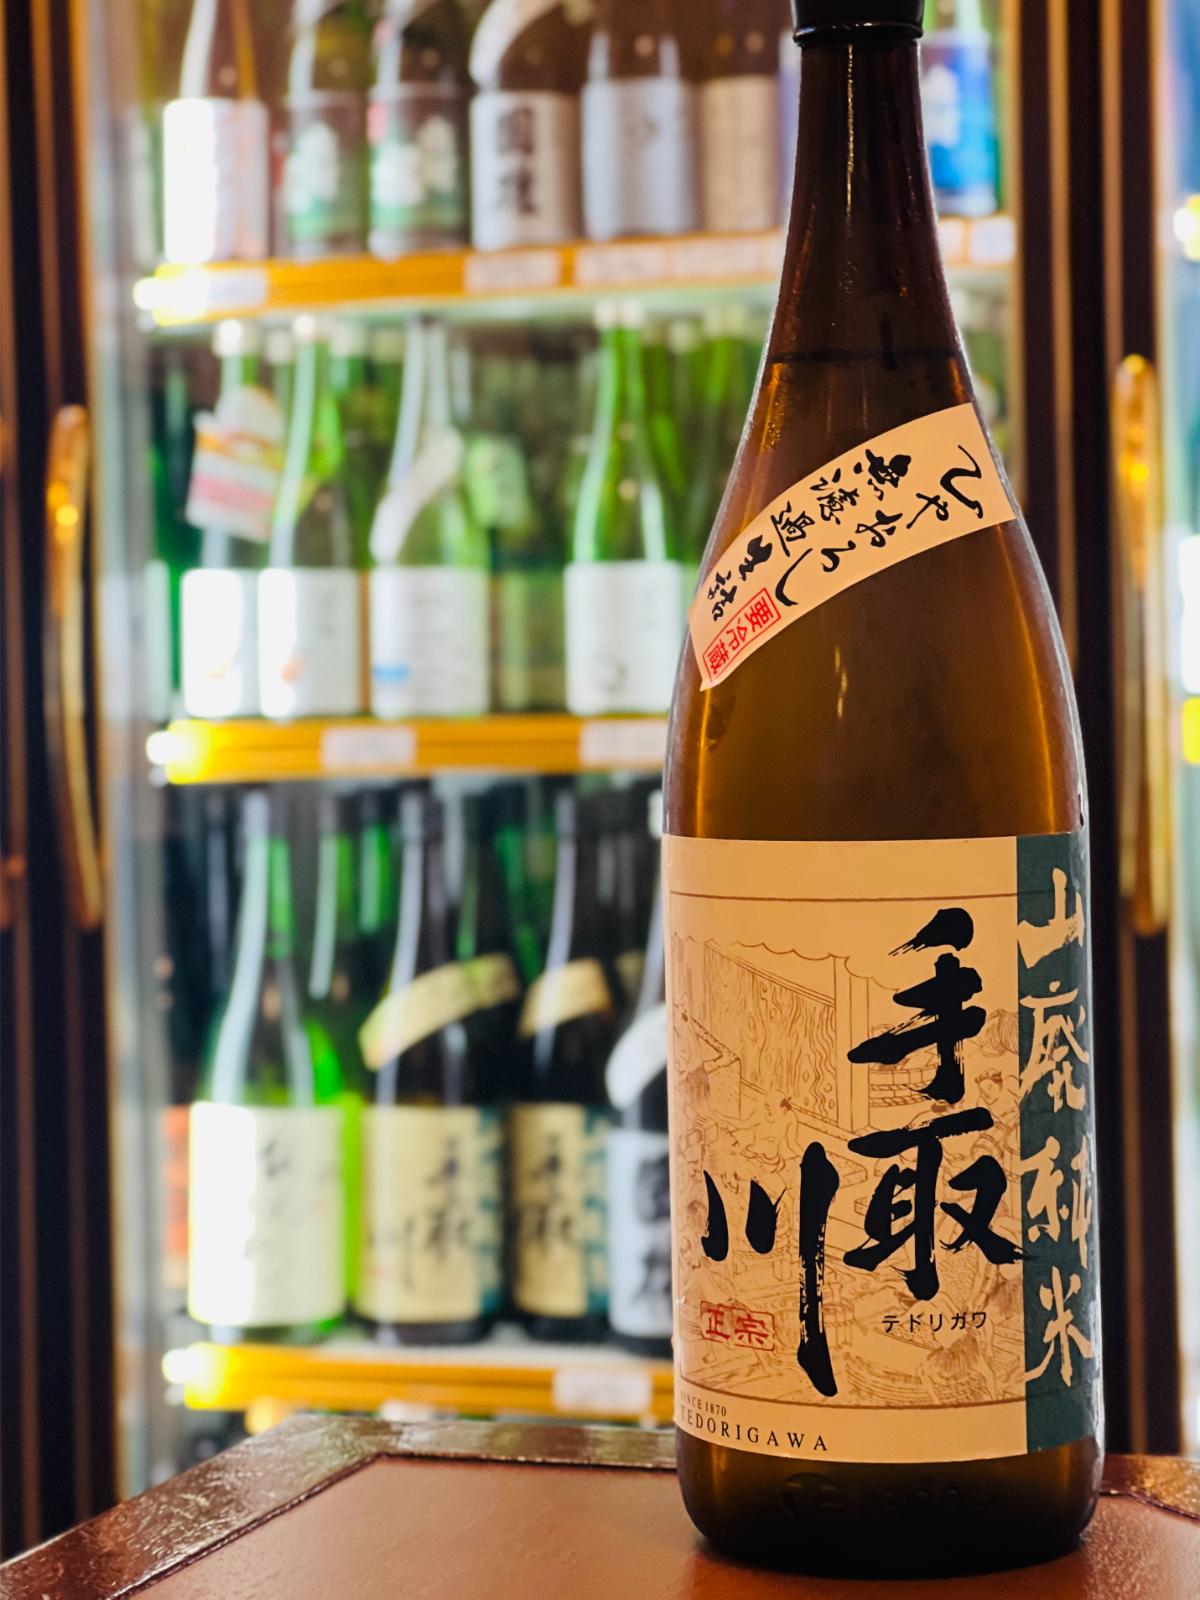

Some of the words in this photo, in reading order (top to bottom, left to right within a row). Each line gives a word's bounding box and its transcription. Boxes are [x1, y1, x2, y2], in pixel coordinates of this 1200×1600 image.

[779, 444, 985, 607] ひやおろし
[706, 594, 775, 675] 要冷蔵
[704, 1307, 770, 1345] 正宗
[881, 1311, 987, 1333] テドリガワ
[680, 1404, 828, 1451] TEDORIGAWA
[705, 1402, 727, 1417] 1870
